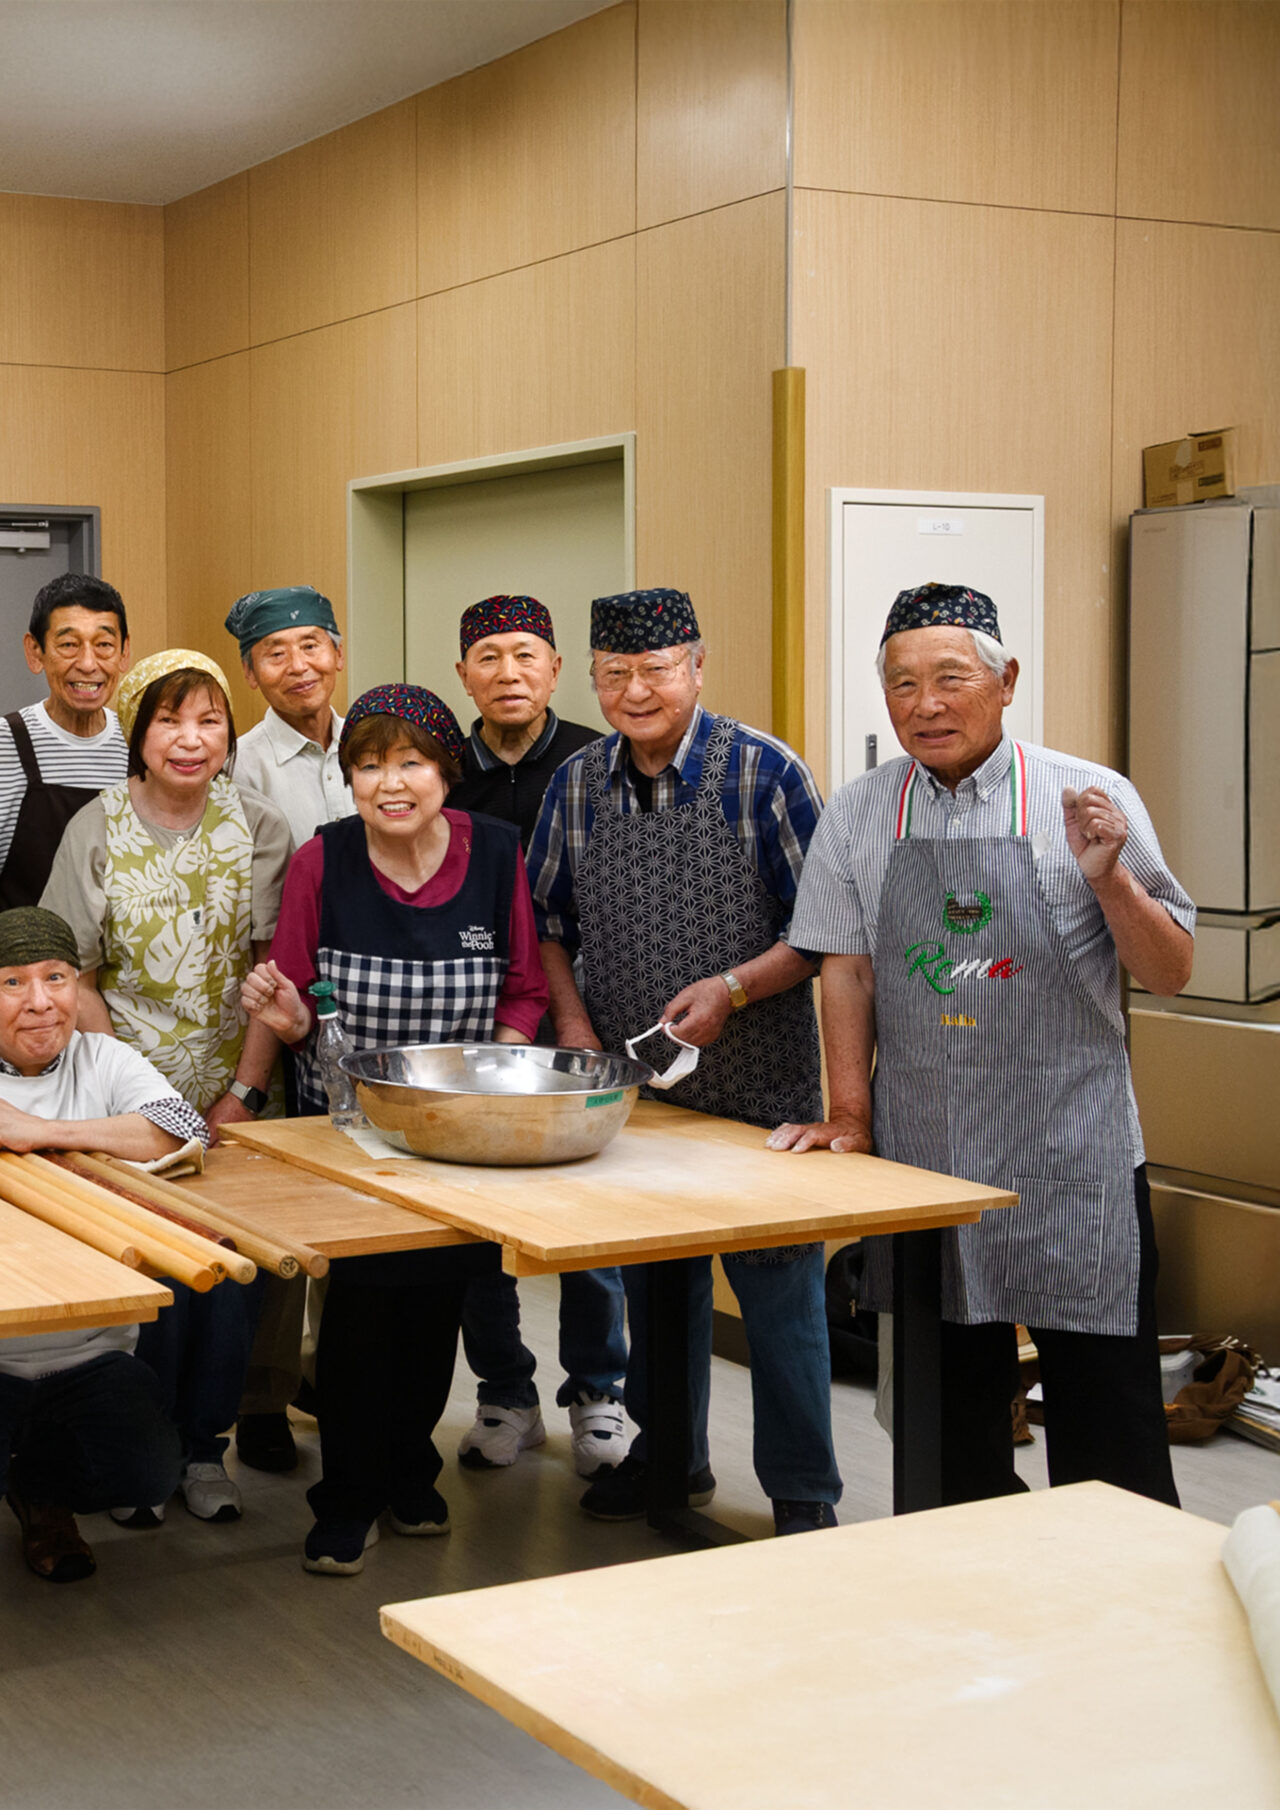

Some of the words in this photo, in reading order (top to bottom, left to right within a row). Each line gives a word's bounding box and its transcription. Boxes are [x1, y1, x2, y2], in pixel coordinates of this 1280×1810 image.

[458, 931, 492, 942] Winnie
[471, 939, 495, 950] Pooh
[905, 940, 1023, 995] Roma
[941, 1013, 976, 1027] Italia
